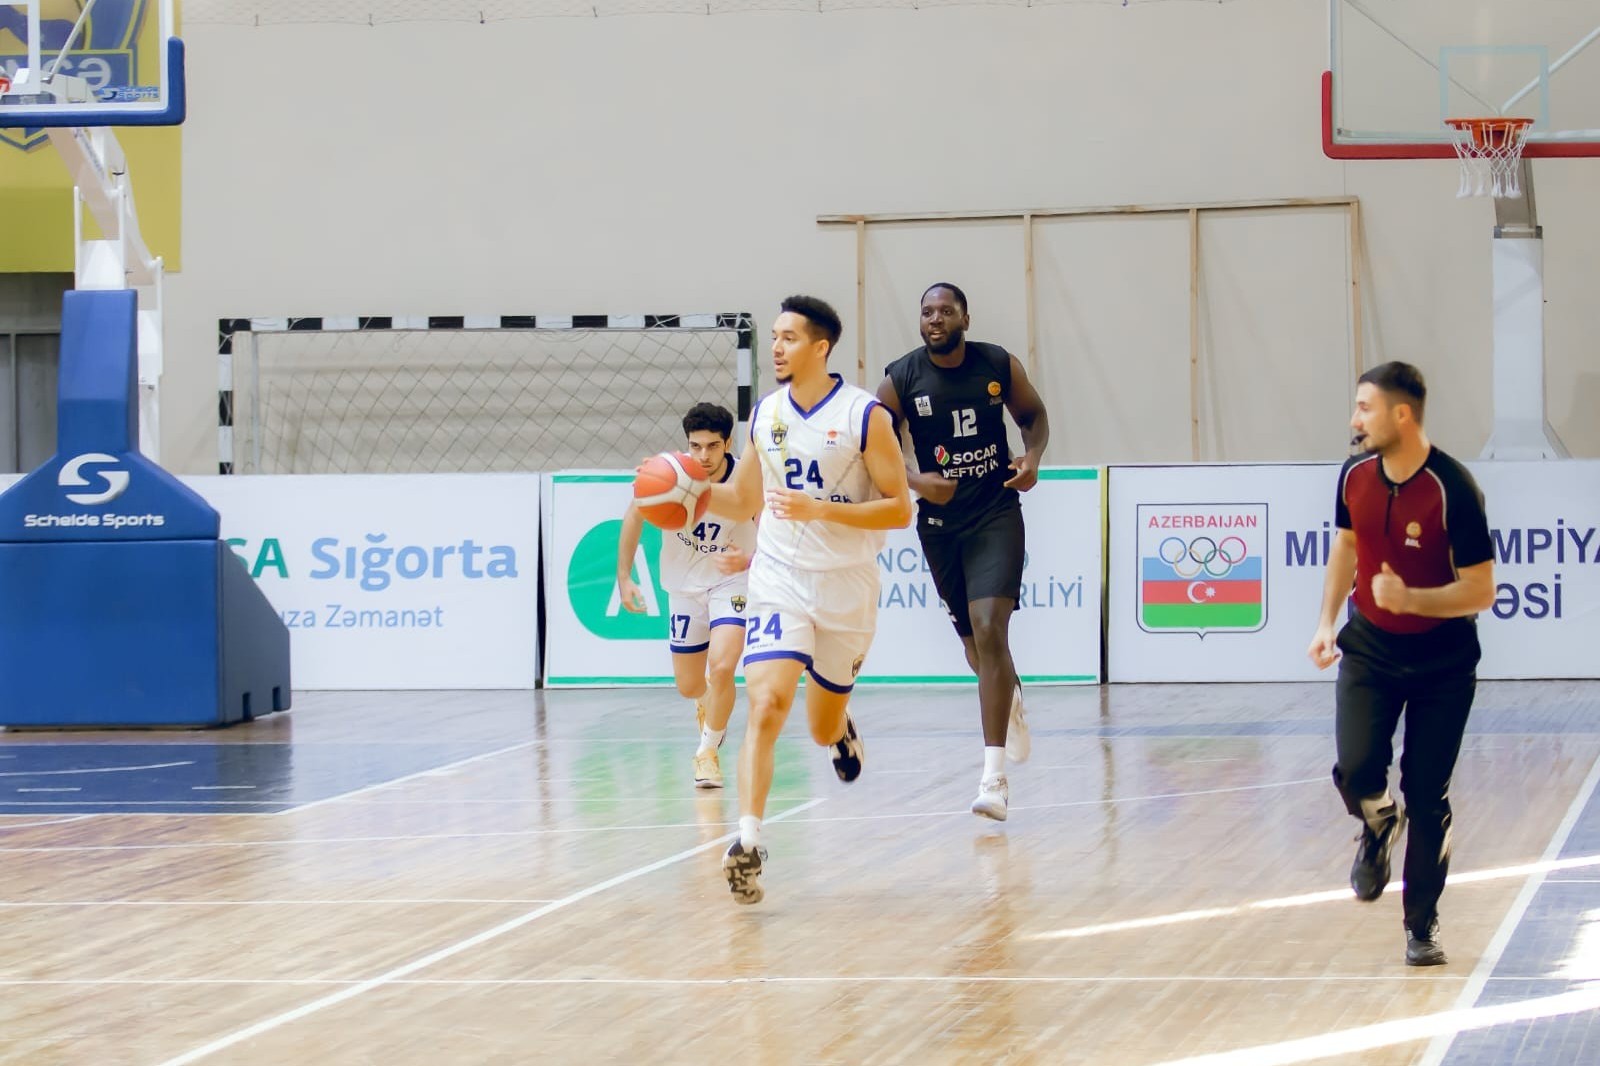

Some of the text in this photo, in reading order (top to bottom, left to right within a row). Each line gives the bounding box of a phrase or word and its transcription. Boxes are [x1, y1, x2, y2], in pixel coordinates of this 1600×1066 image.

[951, 408, 978, 438] 12
[952, 443, 998, 466] SOCAR
[784, 458, 824, 490] 24
[102, 514, 165, 530] Sports
[692, 521, 722, 542] 47
[1147, 515, 1258, 529] AZERBAIJAN
[1285, 521, 1333, 567] Mİ
[1489, 518, 1600, 565] MPİY
[308, 533, 519, 592] Sığorta
[324, 604, 443, 629] Zəmanət
[746, 612, 784, 646] 24
